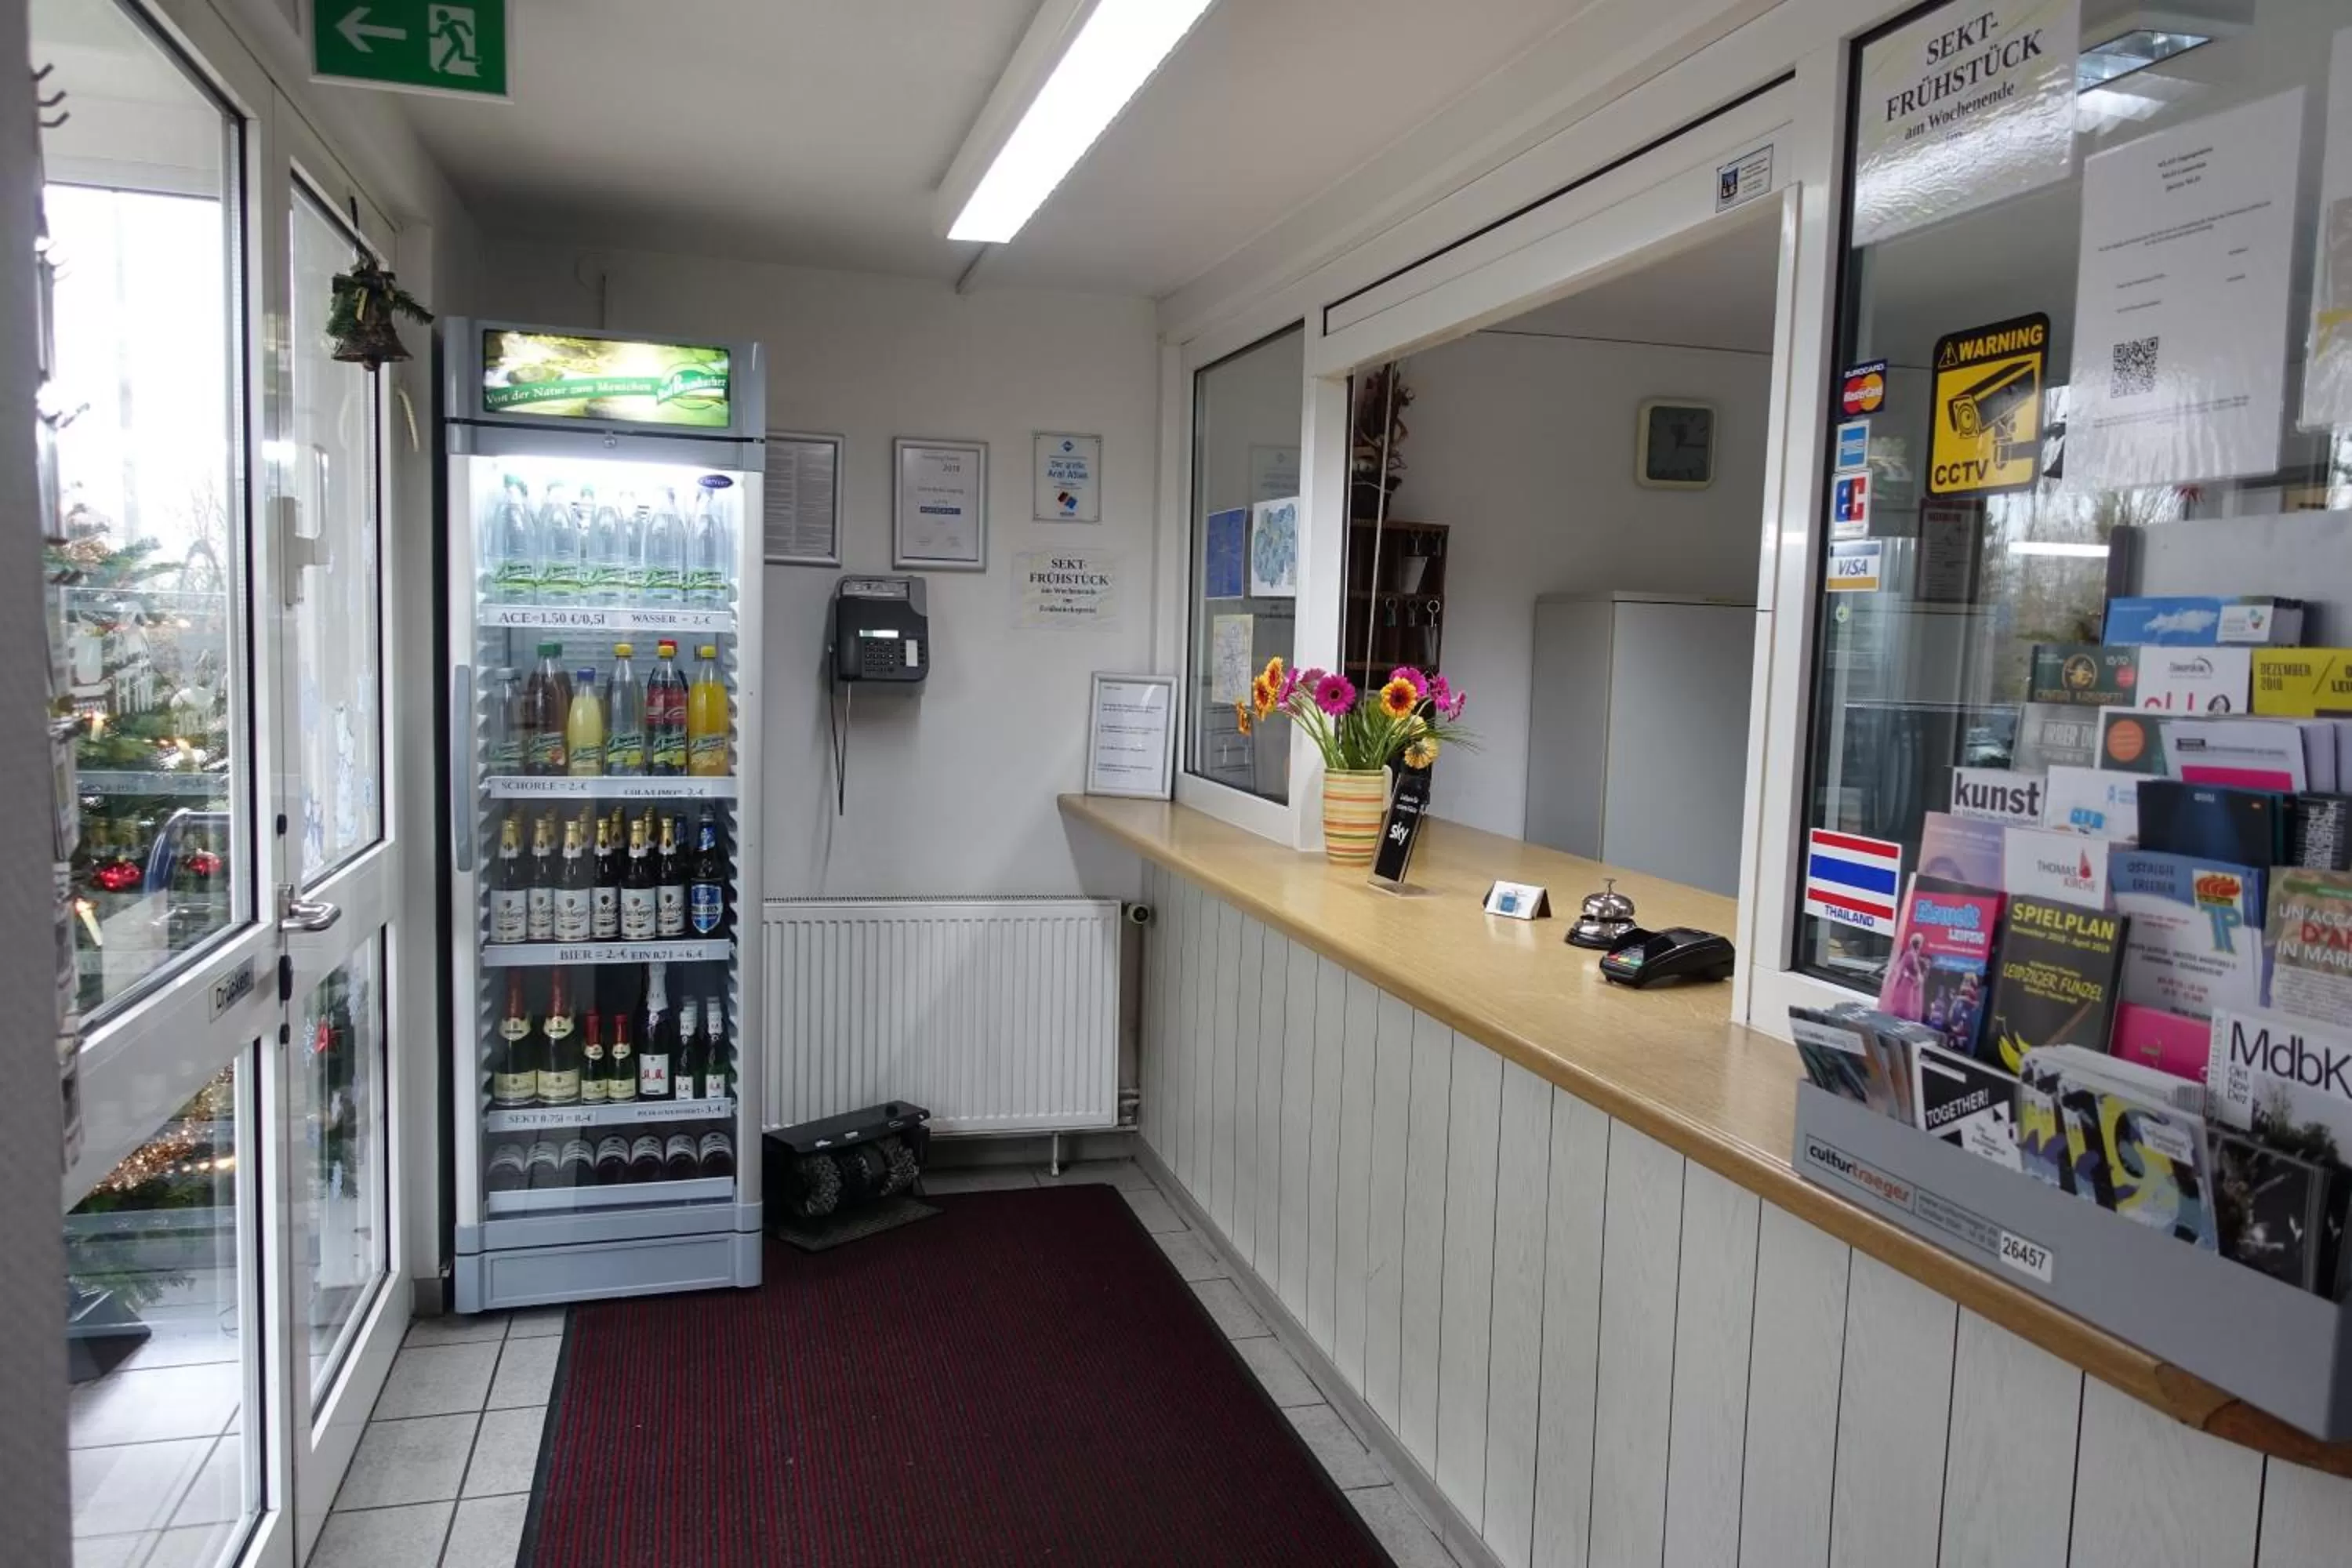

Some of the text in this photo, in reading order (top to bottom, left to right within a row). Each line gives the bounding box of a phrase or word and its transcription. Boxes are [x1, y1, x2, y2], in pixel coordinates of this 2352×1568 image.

[1926, 12, 1998, 65] SEKT-
[1886, 29, 2042, 122] FRÜHSTÜCK
[1905, 82, 2015, 140] am Wochenende
[1959, 324, 2043, 361] WARNING
[512, 389, 529, 401] der
[533, 387, 565, 398] Natur
[1047, 470, 1065, 478] Aral
[1934, 459, 1989, 486] CCTV
[1029, 570, 1109, 586] FRÜHSTÜCK
[1838, 559, 1867, 575] VISA
[631, 615, 676, 623] WASSER
[2261, 663, 2311, 677] DEZEMBER
[501, 782, 556, 791] SCHORLE
[1955, 772, 2040, 816] kunst
[1389, 822, 1410, 846] sky
[2037, 859, 2077, 876] THOMAS
[1825, 904, 1875, 927] THAILAND
[2013, 902, 2115, 941] SPIELPLAN
[560, 950, 593, 961] BIER
[2277, 940, 2298, 957] IN
[2003, 961, 2059, 991] LEIPZIGER
[2231, 1020, 2352, 1099] MdbK
[1926, 1087, 1989, 1127] TOGETHER!
[508, 1116, 539, 1124] SEKT
[1809, 1145, 1909, 1203] culturtraeger
[2002, 1236, 2046, 1270] 26457
